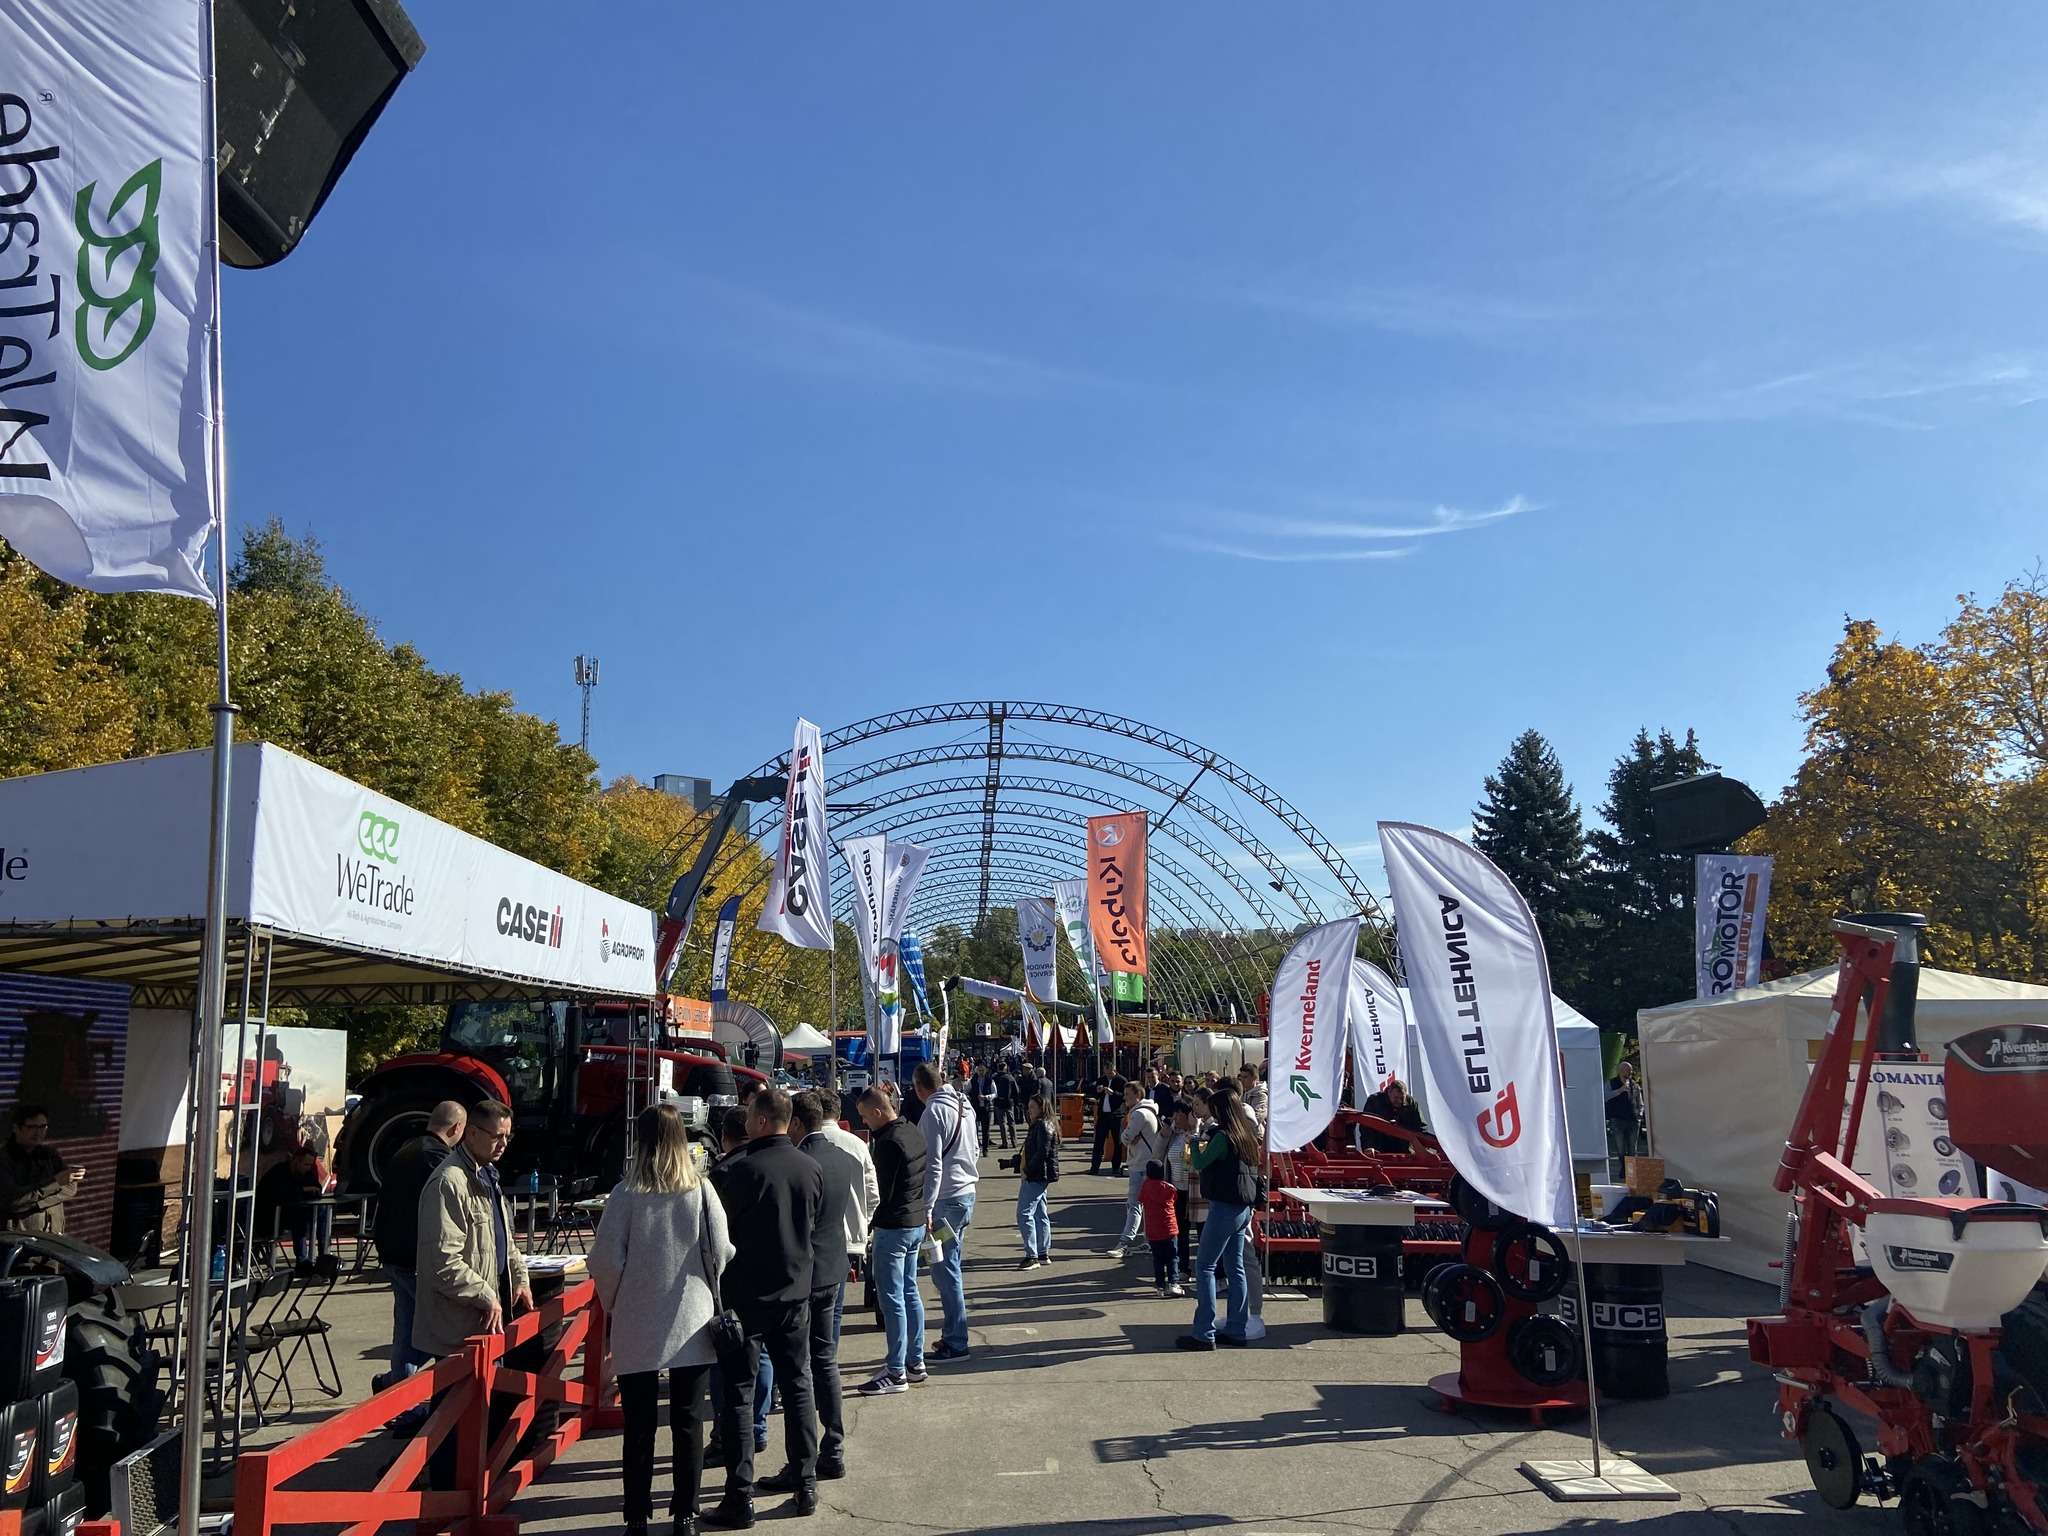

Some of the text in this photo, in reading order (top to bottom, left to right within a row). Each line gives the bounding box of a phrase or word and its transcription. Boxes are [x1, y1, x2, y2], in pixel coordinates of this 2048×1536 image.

[337, 853, 414, 915] WeTrade
[496, 896, 549, 945] CASE
[1711, 871, 1746, 996] ROMOTOR
[611, 941, 645, 963] AGROPROFI
[1735, 912, 1753, 989] REMIUM
[1295, 959, 1321, 1071] Kverneland
[2002, 1040, 2048, 1054] Kvernela
[1867, 1071, 1945, 1086] OMANIA
[1325, 1256, 1375, 1275] JCB
[1594, 1305, 1661, 1328] JCB
